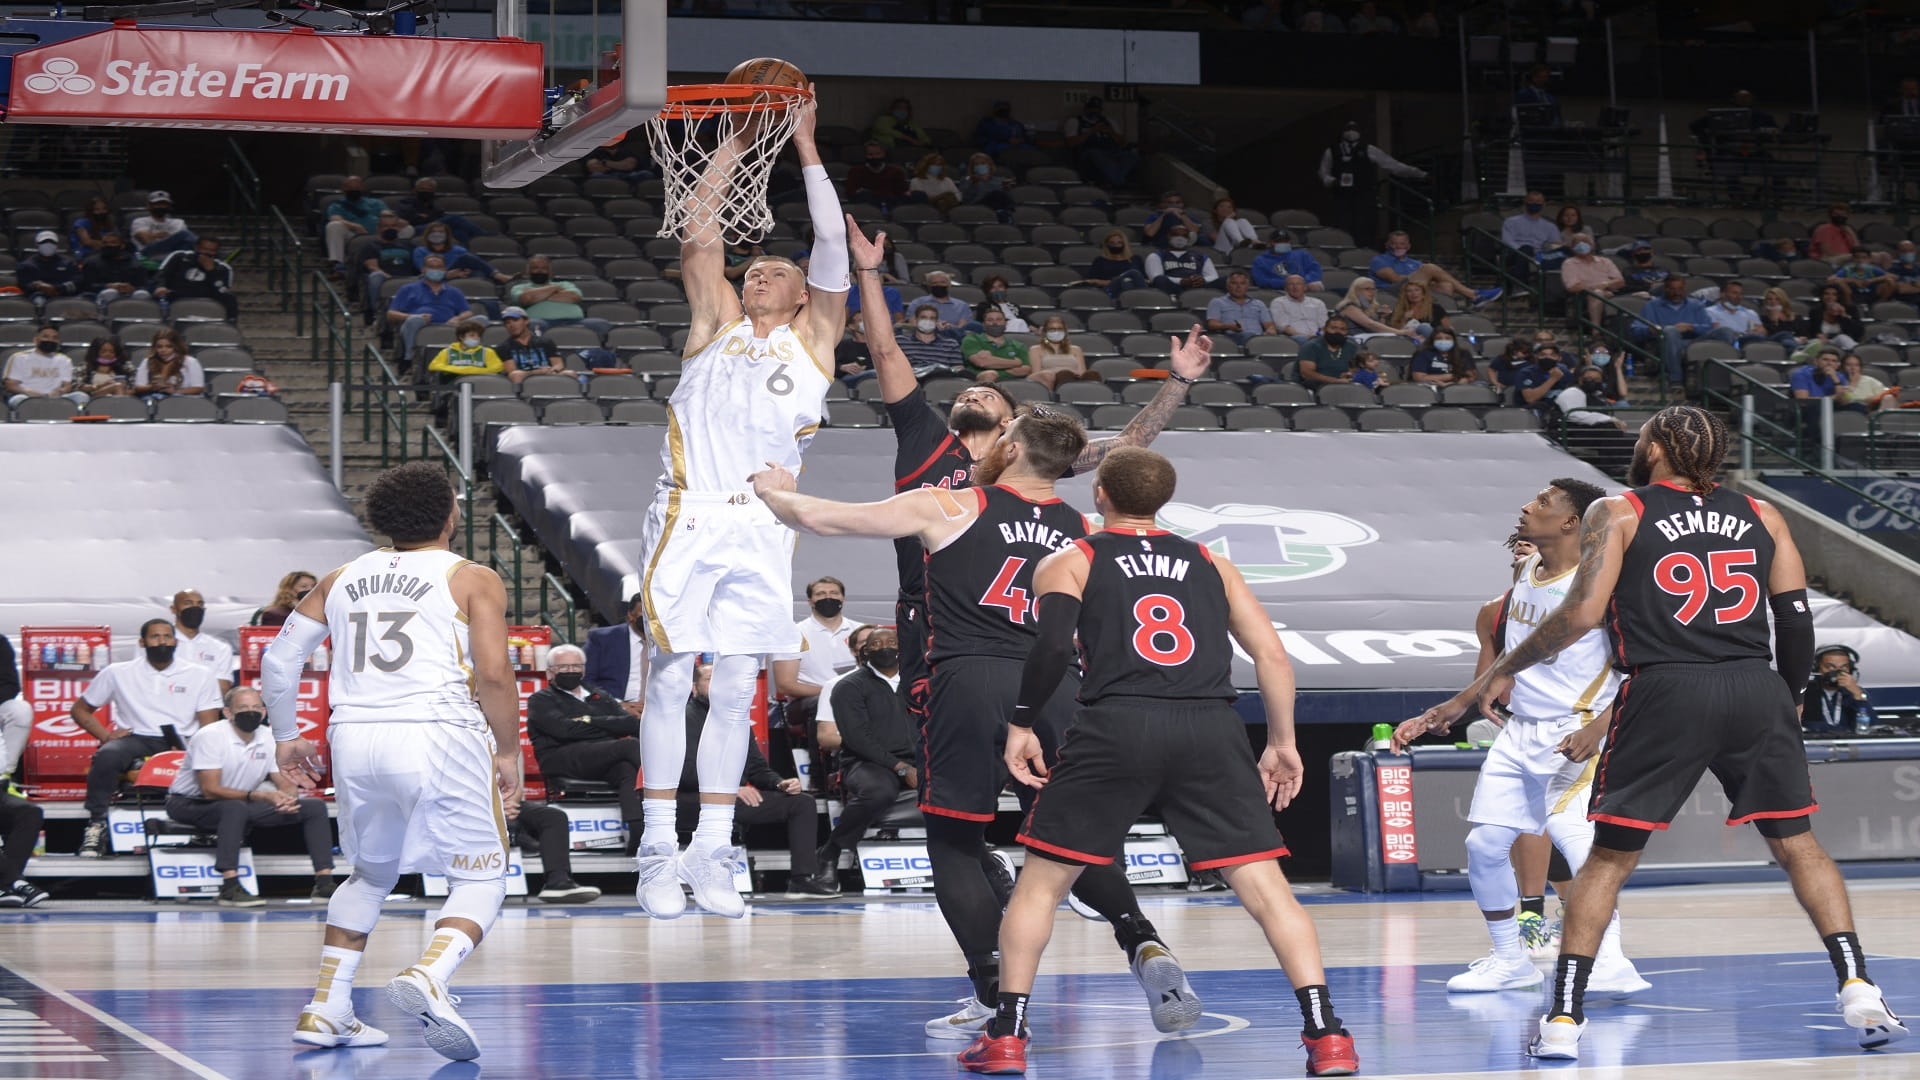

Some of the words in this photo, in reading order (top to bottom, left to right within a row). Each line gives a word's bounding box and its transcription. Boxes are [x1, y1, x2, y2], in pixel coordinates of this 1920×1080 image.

[766, 364, 795, 396] 6
[1654, 511, 1753, 542] BEMBRY
[1114, 554, 1190, 581] FLYNN
[345, 573, 433, 603] BRUNSON
[977, 556, 1040, 625] 4
[1653, 549, 1760, 626] 95
[348, 611, 418, 674] 13
[1133, 593, 1195, 667] 8
[1381, 769, 1410, 779] BIO
[1383, 801, 1412, 812] BIO
[1385, 834, 1415, 845] BIO
[452, 852, 502, 871] MAVS
